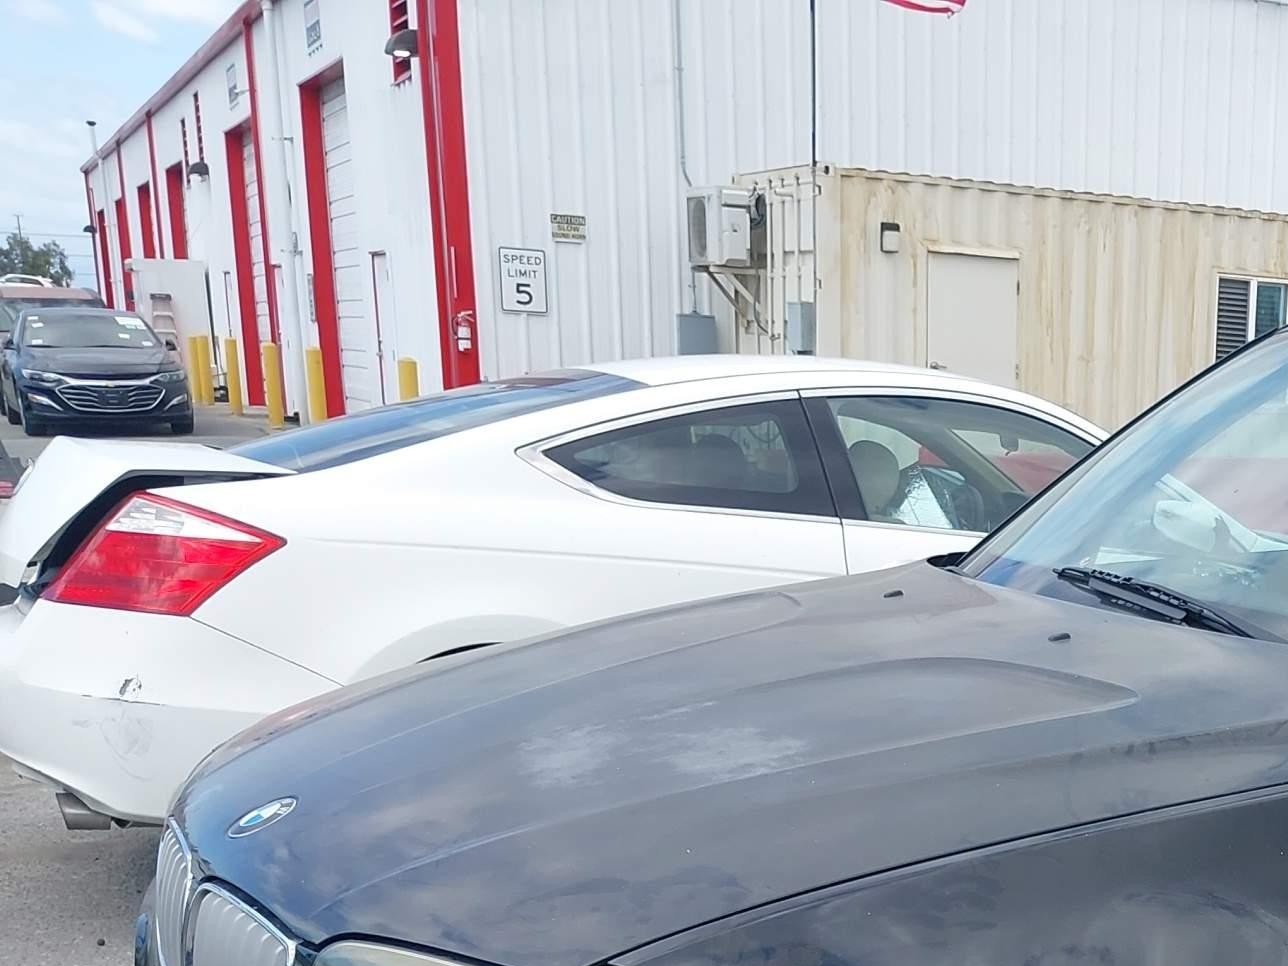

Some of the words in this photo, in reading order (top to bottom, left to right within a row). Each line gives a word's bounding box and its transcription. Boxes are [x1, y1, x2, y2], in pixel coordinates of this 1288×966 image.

[551, 215, 586, 225] CAUTION
[503, 254, 542, 266] SPEED
[507, 268, 538, 279] LIMIT
[515, 283, 533, 305] 5
